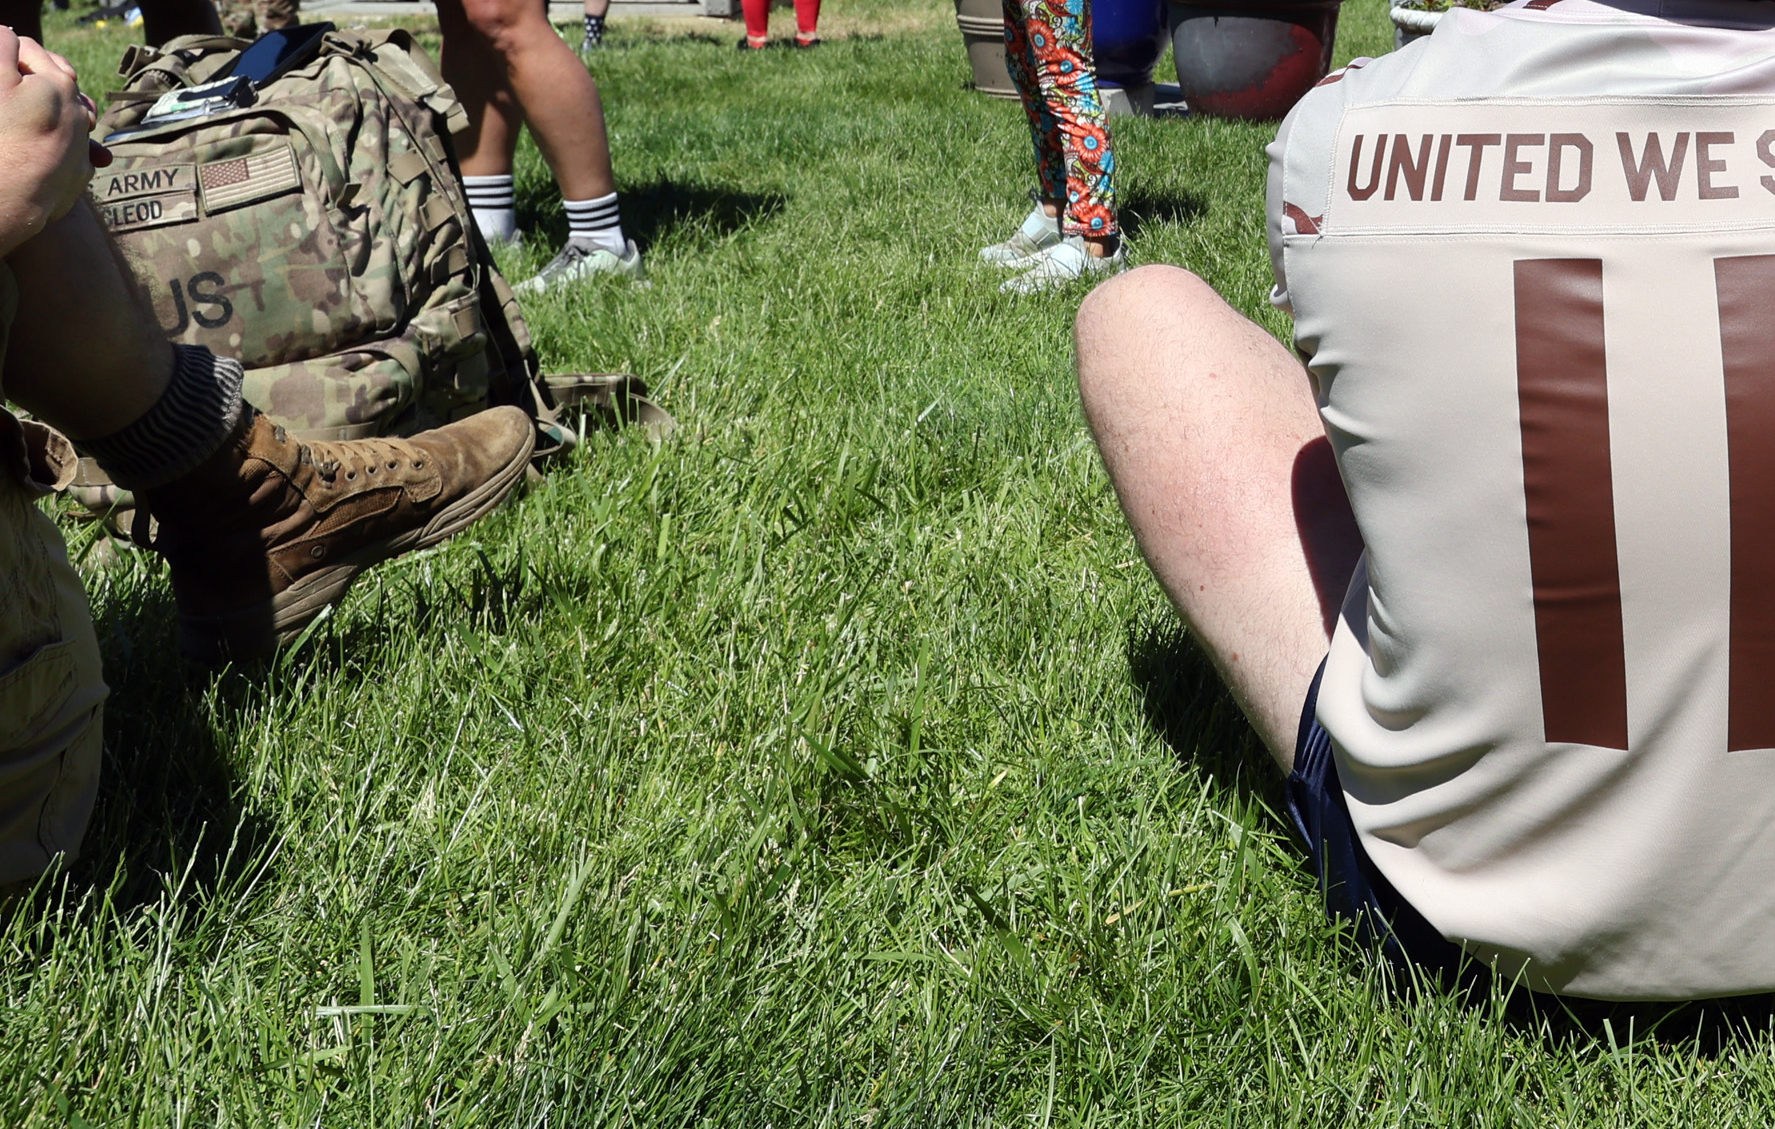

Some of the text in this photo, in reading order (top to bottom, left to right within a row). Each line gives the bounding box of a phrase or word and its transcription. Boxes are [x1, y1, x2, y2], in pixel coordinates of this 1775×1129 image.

[107, 167, 180, 197] ARMY
[1347, 132, 1594, 203] UNITED
[1615, 131, 1740, 202] WE
